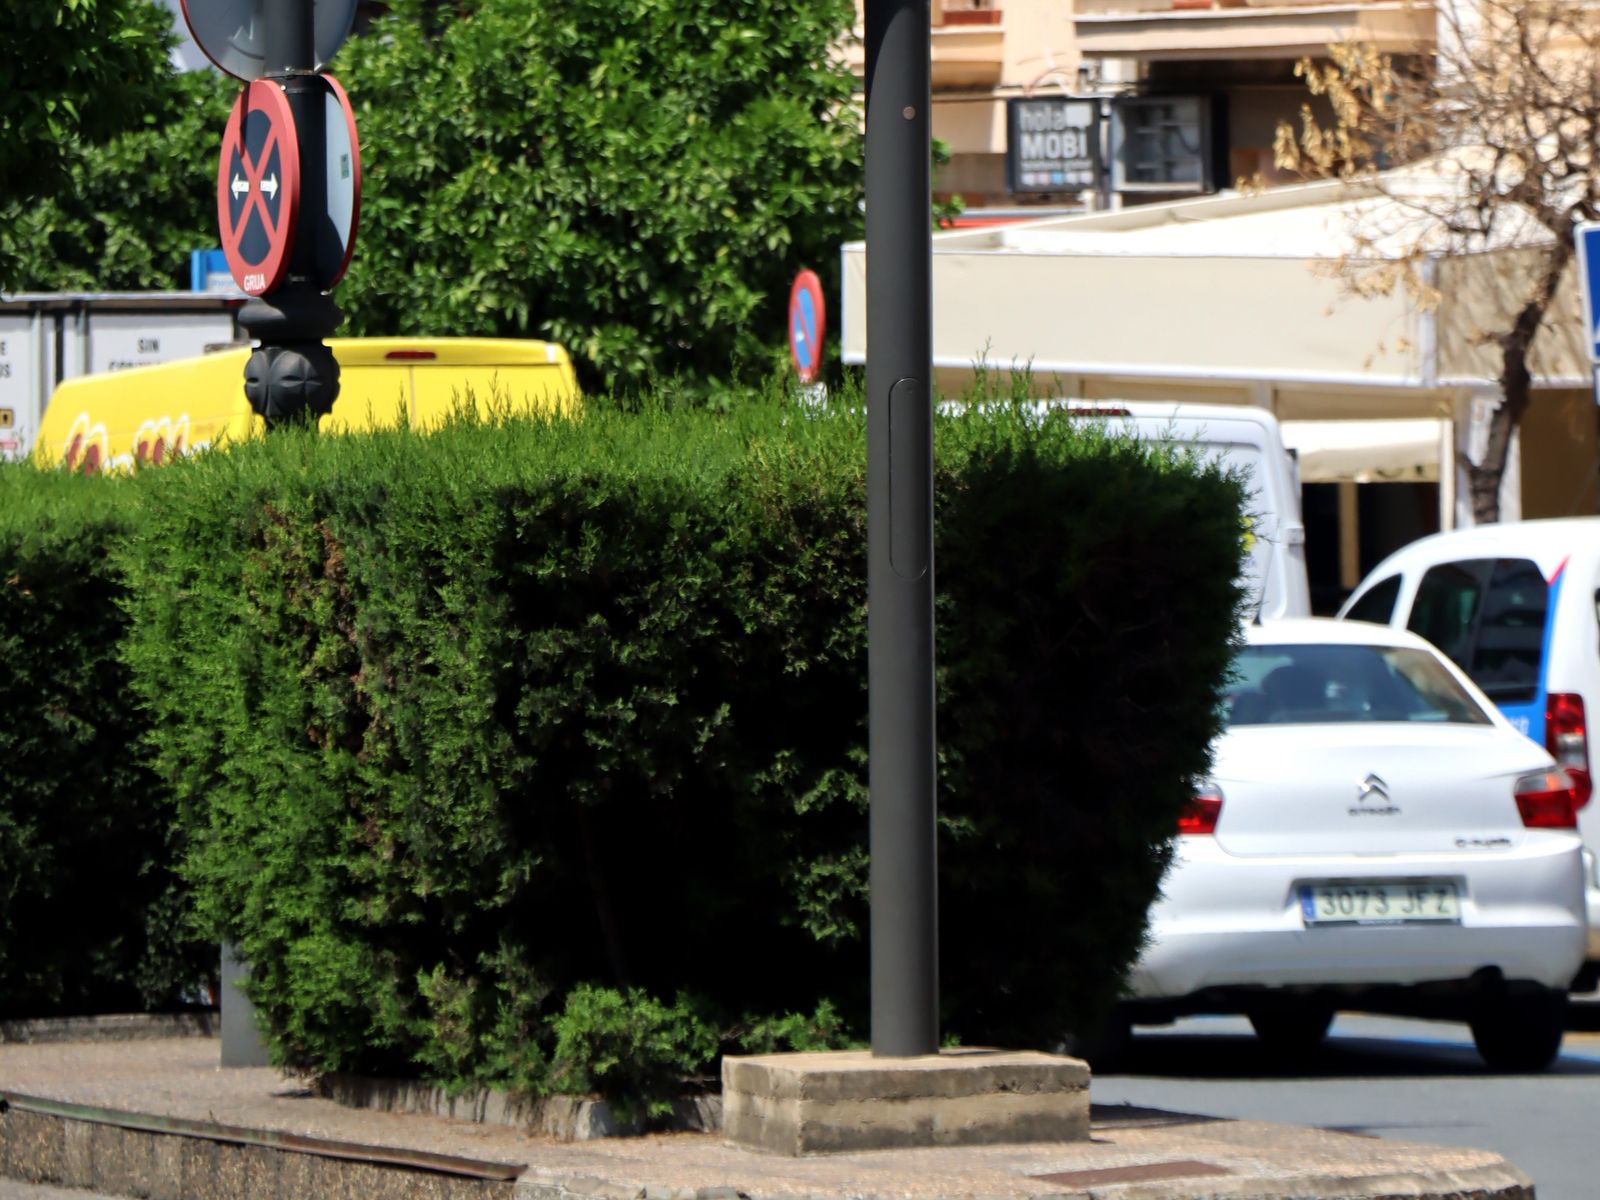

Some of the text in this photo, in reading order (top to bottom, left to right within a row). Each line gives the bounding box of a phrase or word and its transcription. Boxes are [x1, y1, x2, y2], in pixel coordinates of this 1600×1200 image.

[1019, 105, 1065, 131] hola
[1021, 131, 1087, 159] MOBI
[243, 273, 266, 291] GRUA
[1323, 889, 1390, 915] 3073
